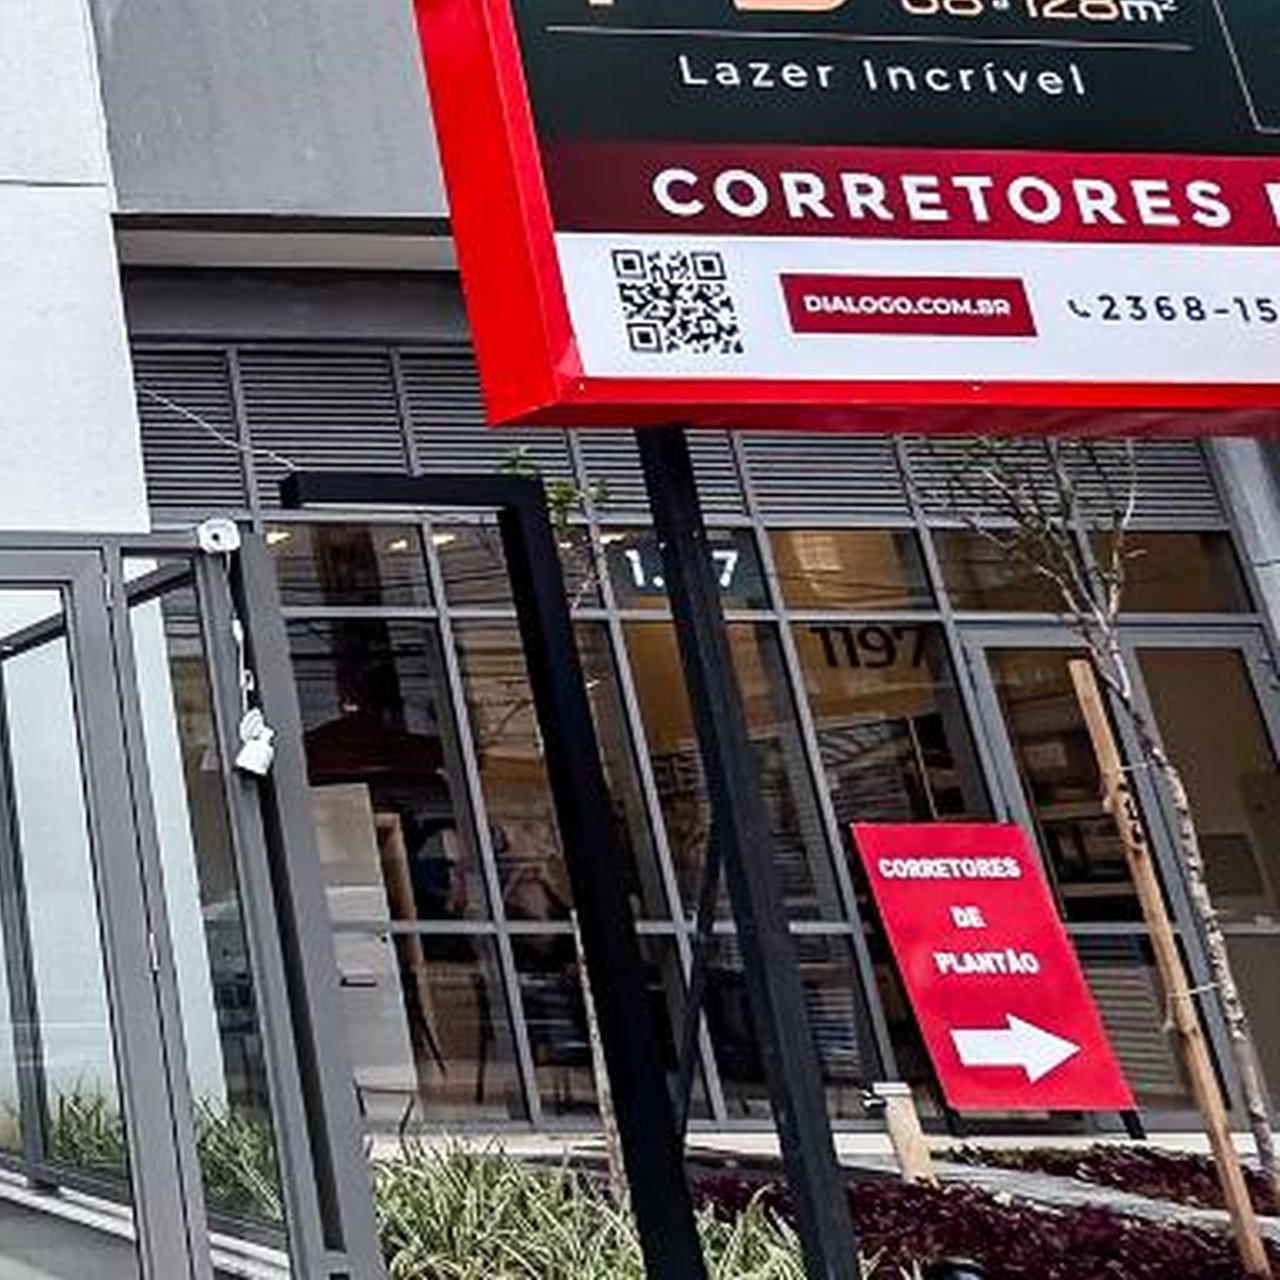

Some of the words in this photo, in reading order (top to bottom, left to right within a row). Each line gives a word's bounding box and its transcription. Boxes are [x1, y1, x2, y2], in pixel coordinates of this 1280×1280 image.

[678, 56, 834, 90] Lazer
[862, 60, 1086, 95] Incrível
[651, 168, 1232, 228] CORRETORES
[803, 294, 1011, 317] DIALOGO.COM.BR
[1096, 294, 1279, 324] 2368-15
[624, 549, 739, 588] 17
[810, 625, 932, 669] 1197
[878, 857, 1022, 879] CORRETORES
[950, 906, 987, 929] DE
[933, 948, 1040, 975] PLANTÃO
